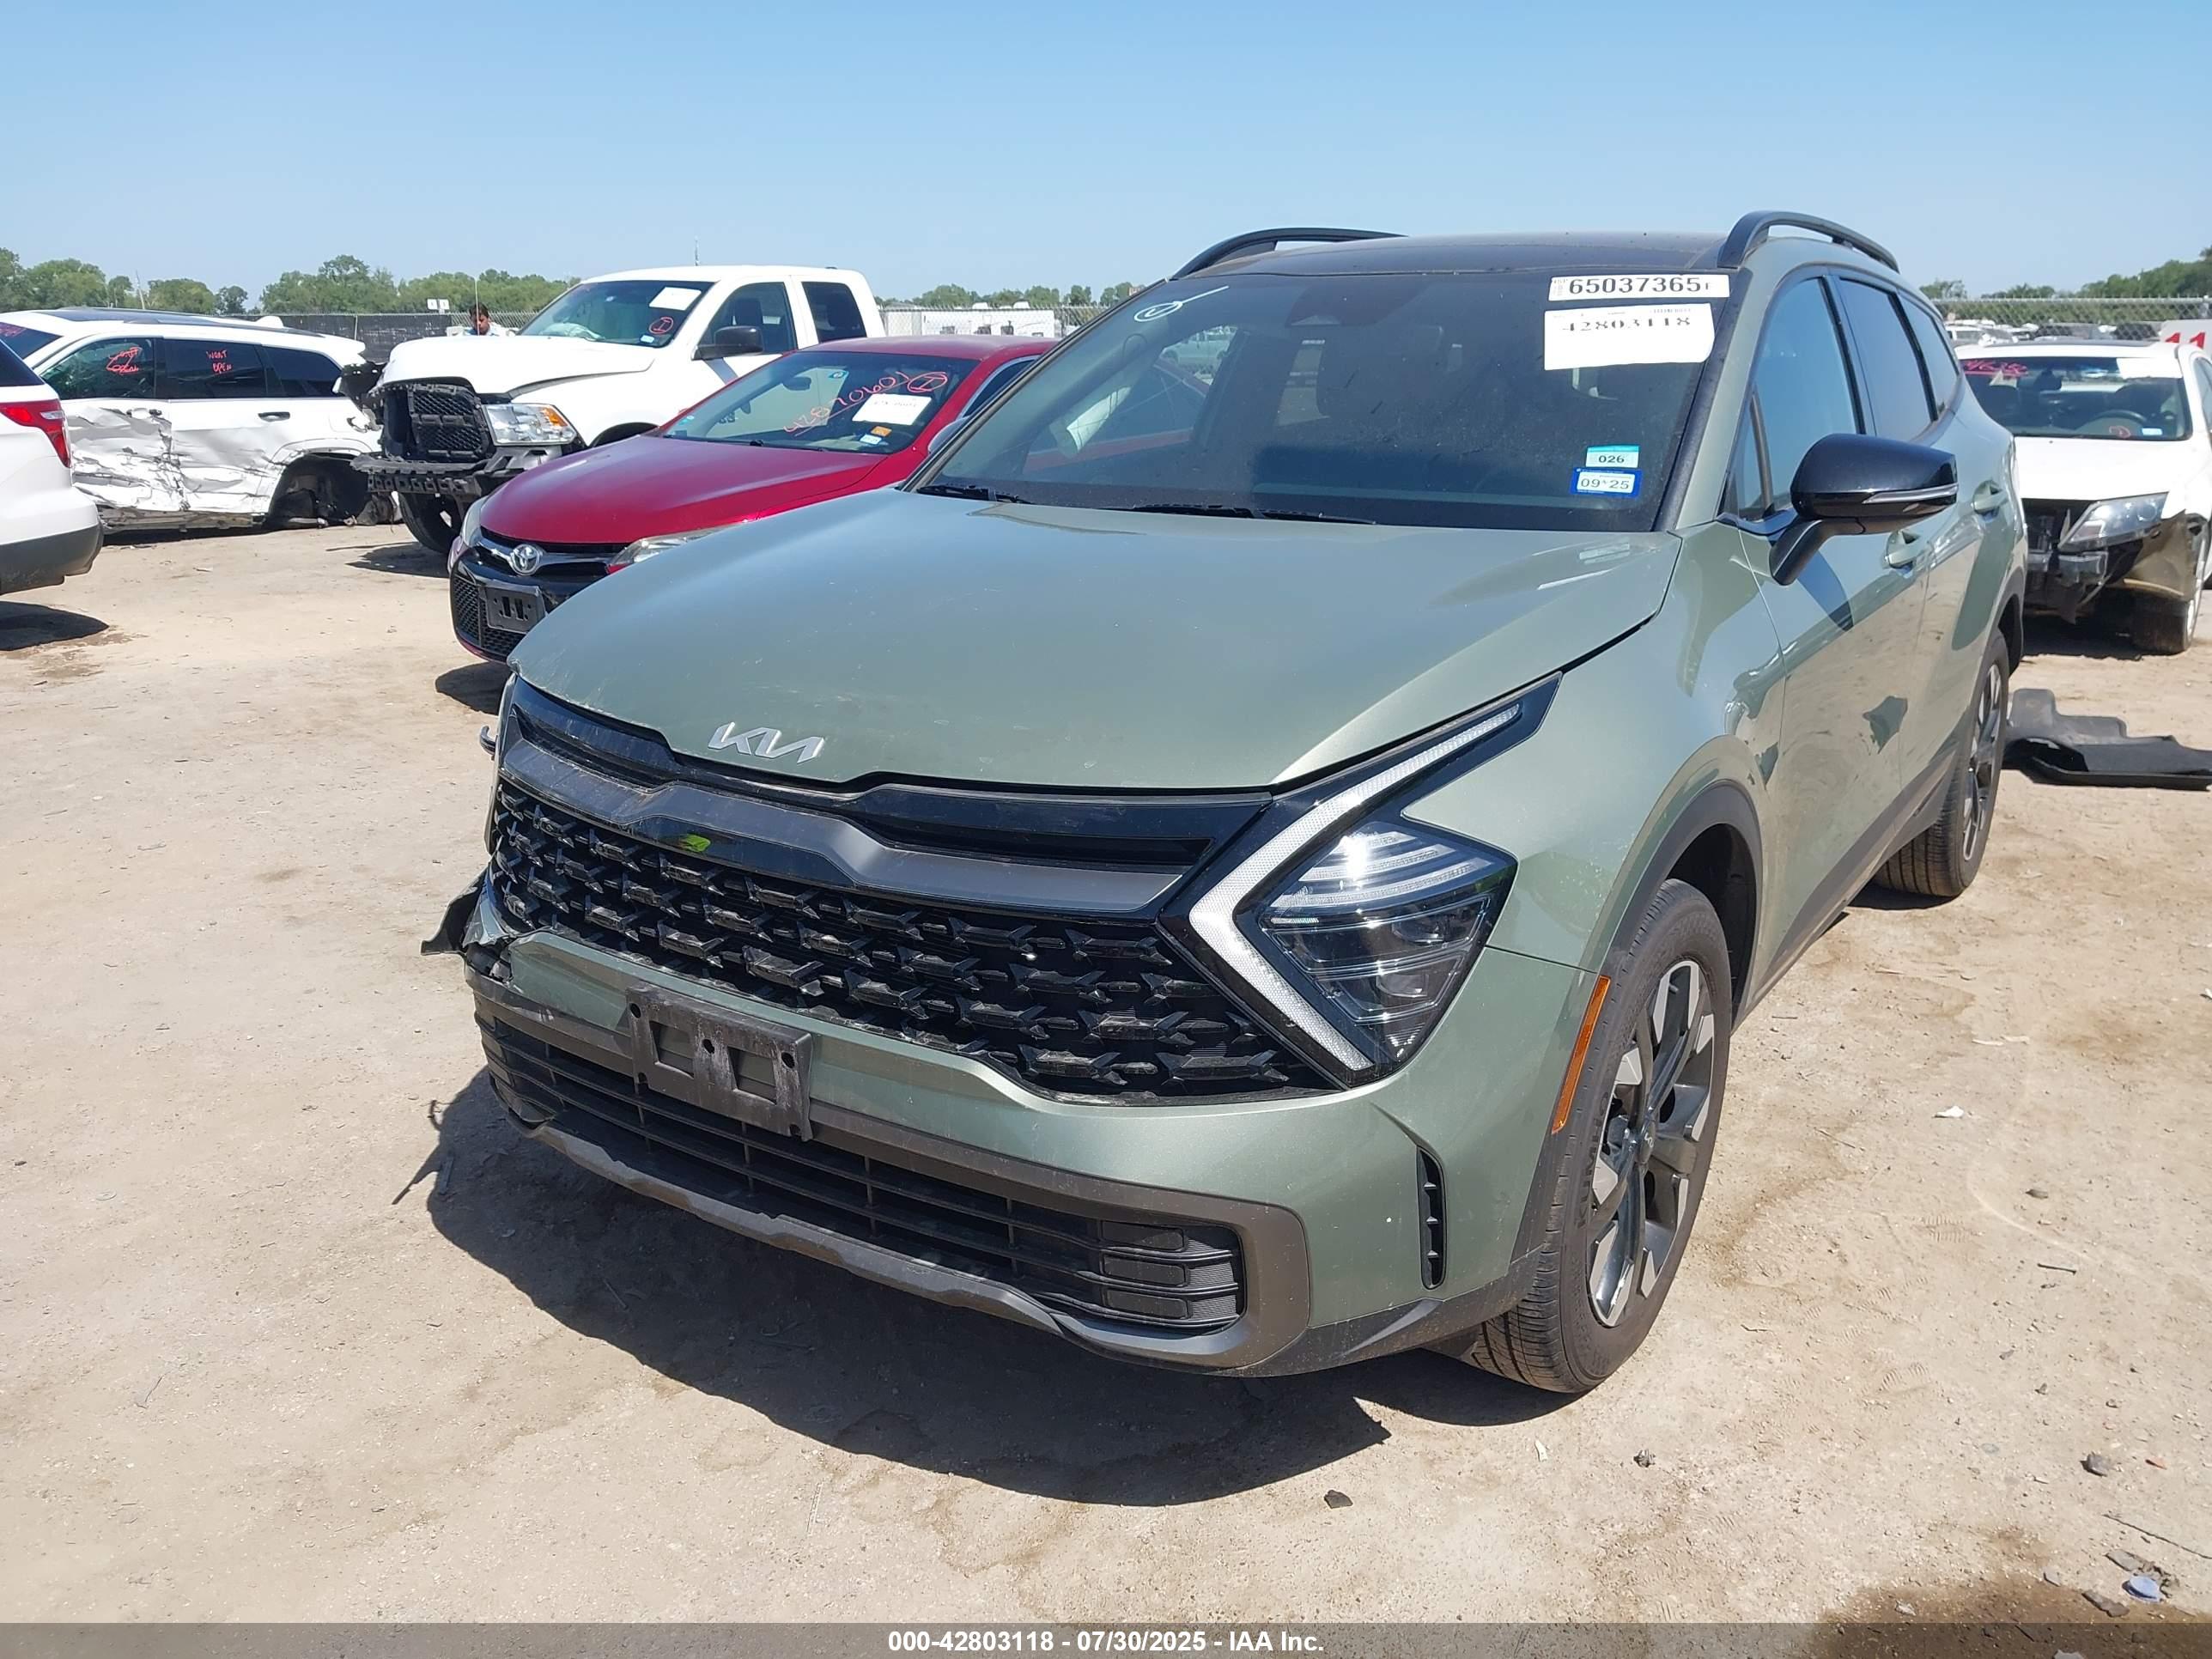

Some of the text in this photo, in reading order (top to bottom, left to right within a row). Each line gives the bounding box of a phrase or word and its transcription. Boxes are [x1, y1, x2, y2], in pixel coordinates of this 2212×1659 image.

[1568, 276, 1702, 295] 65037365
[1598, 455, 1625, 464] 026
[708, 722, 824, 763] KIA
